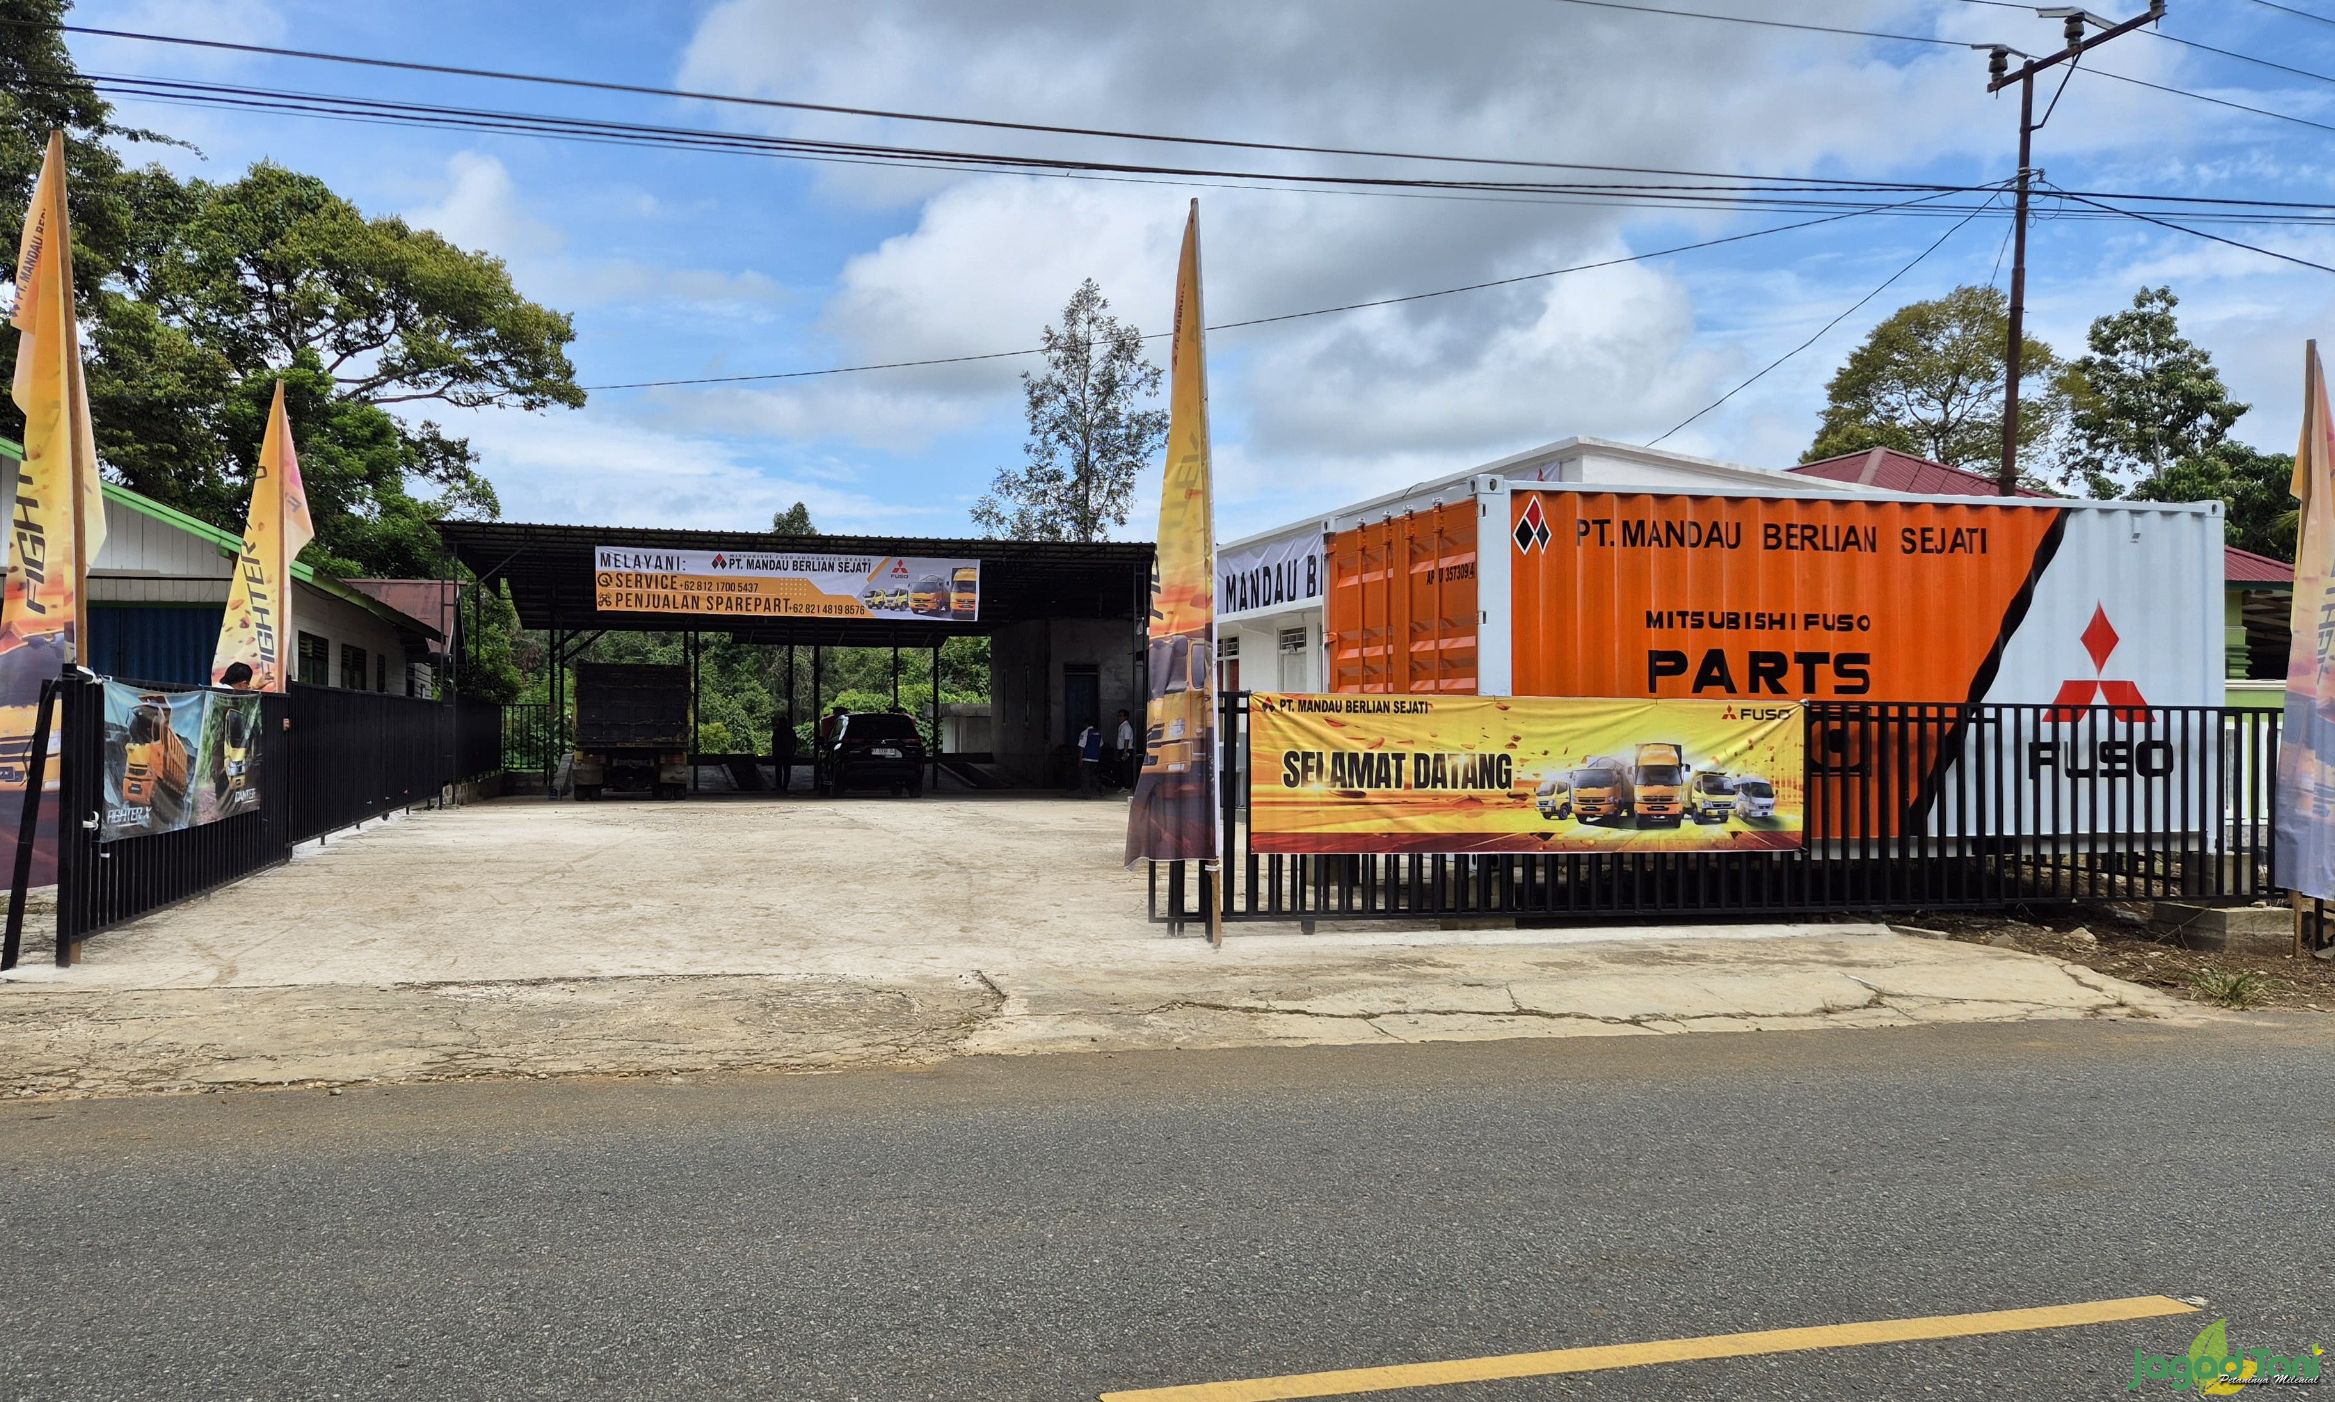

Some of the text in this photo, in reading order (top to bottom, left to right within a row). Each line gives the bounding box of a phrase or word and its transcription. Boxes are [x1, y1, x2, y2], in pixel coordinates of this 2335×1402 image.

[1763, 522, 1877, 553] BERLIAN
[1901, 527, 1988, 554] SEJATI
[600, 552, 686, 571] MELAYANI:
[729, 558, 871, 573] PT. MANDAU BERLIAN SEJATI
[615, 572, 678, 590] SERVICE
[679, 580, 695, 591] +62
[716, 582, 736, 592] 1700
[738, 582, 759, 593] 5437
[1225, 558, 1298, 613] MANDAU
[1306, 552, 1323, 598] B
[616, 592, 700, 610] PENJUALAN
[706, 595, 790, 614] SPAREPART
[1645, 610, 1871, 632] MITSUBISHI FUSO
[1648, 648, 1871, 695] PARTS
[1280, 699, 1429, 714] PT. MANDAU BERLIAN SEJATI
[1740, 708, 1791, 721] FUSO
[1283, 751, 1512, 790] SELAMAT DATANG
